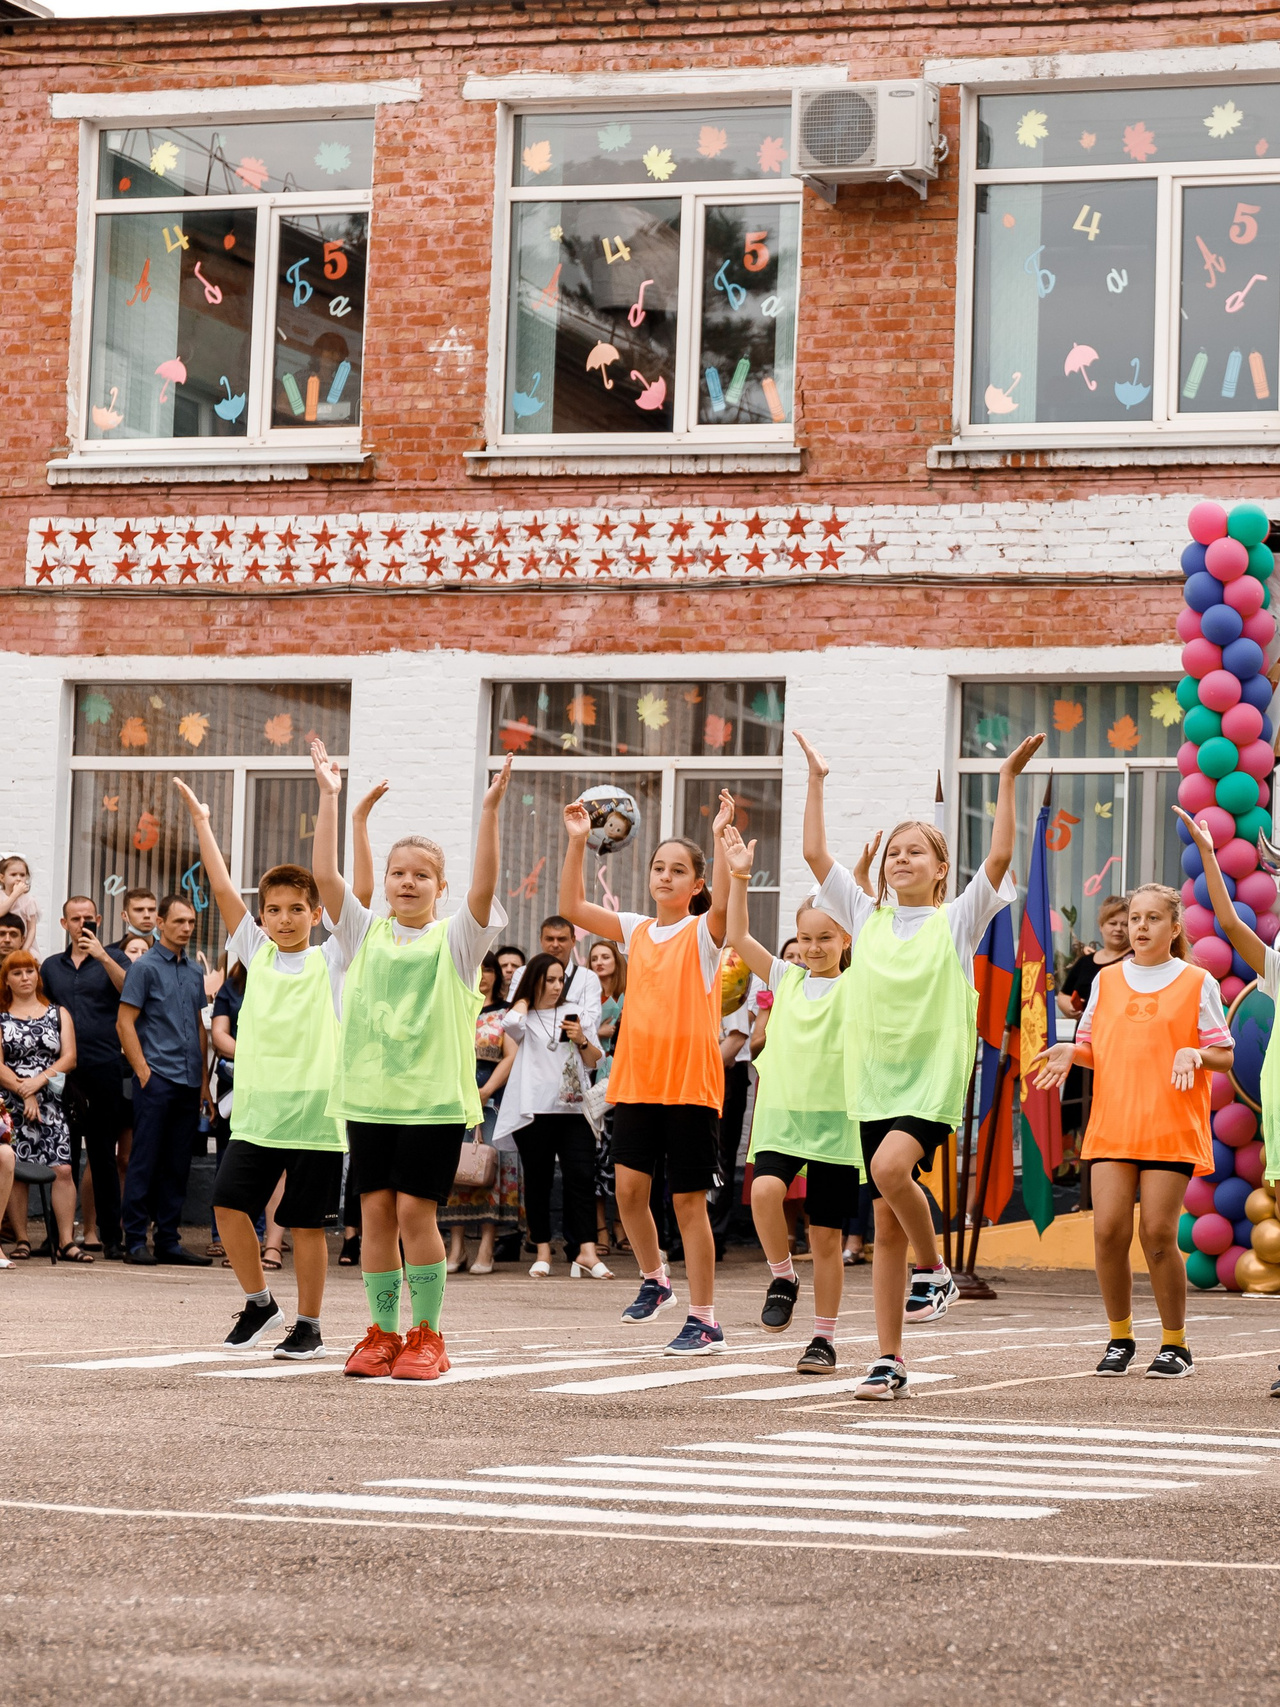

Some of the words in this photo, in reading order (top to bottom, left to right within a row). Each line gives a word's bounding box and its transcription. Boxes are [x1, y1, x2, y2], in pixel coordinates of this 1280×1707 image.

[1229, 202, 1261, 245] 5
[323, 239, 348, 280] 5
[743, 230, 770, 272] 5
[133, 811, 160, 851] 5
[1045, 808, 1081, 851] 5
